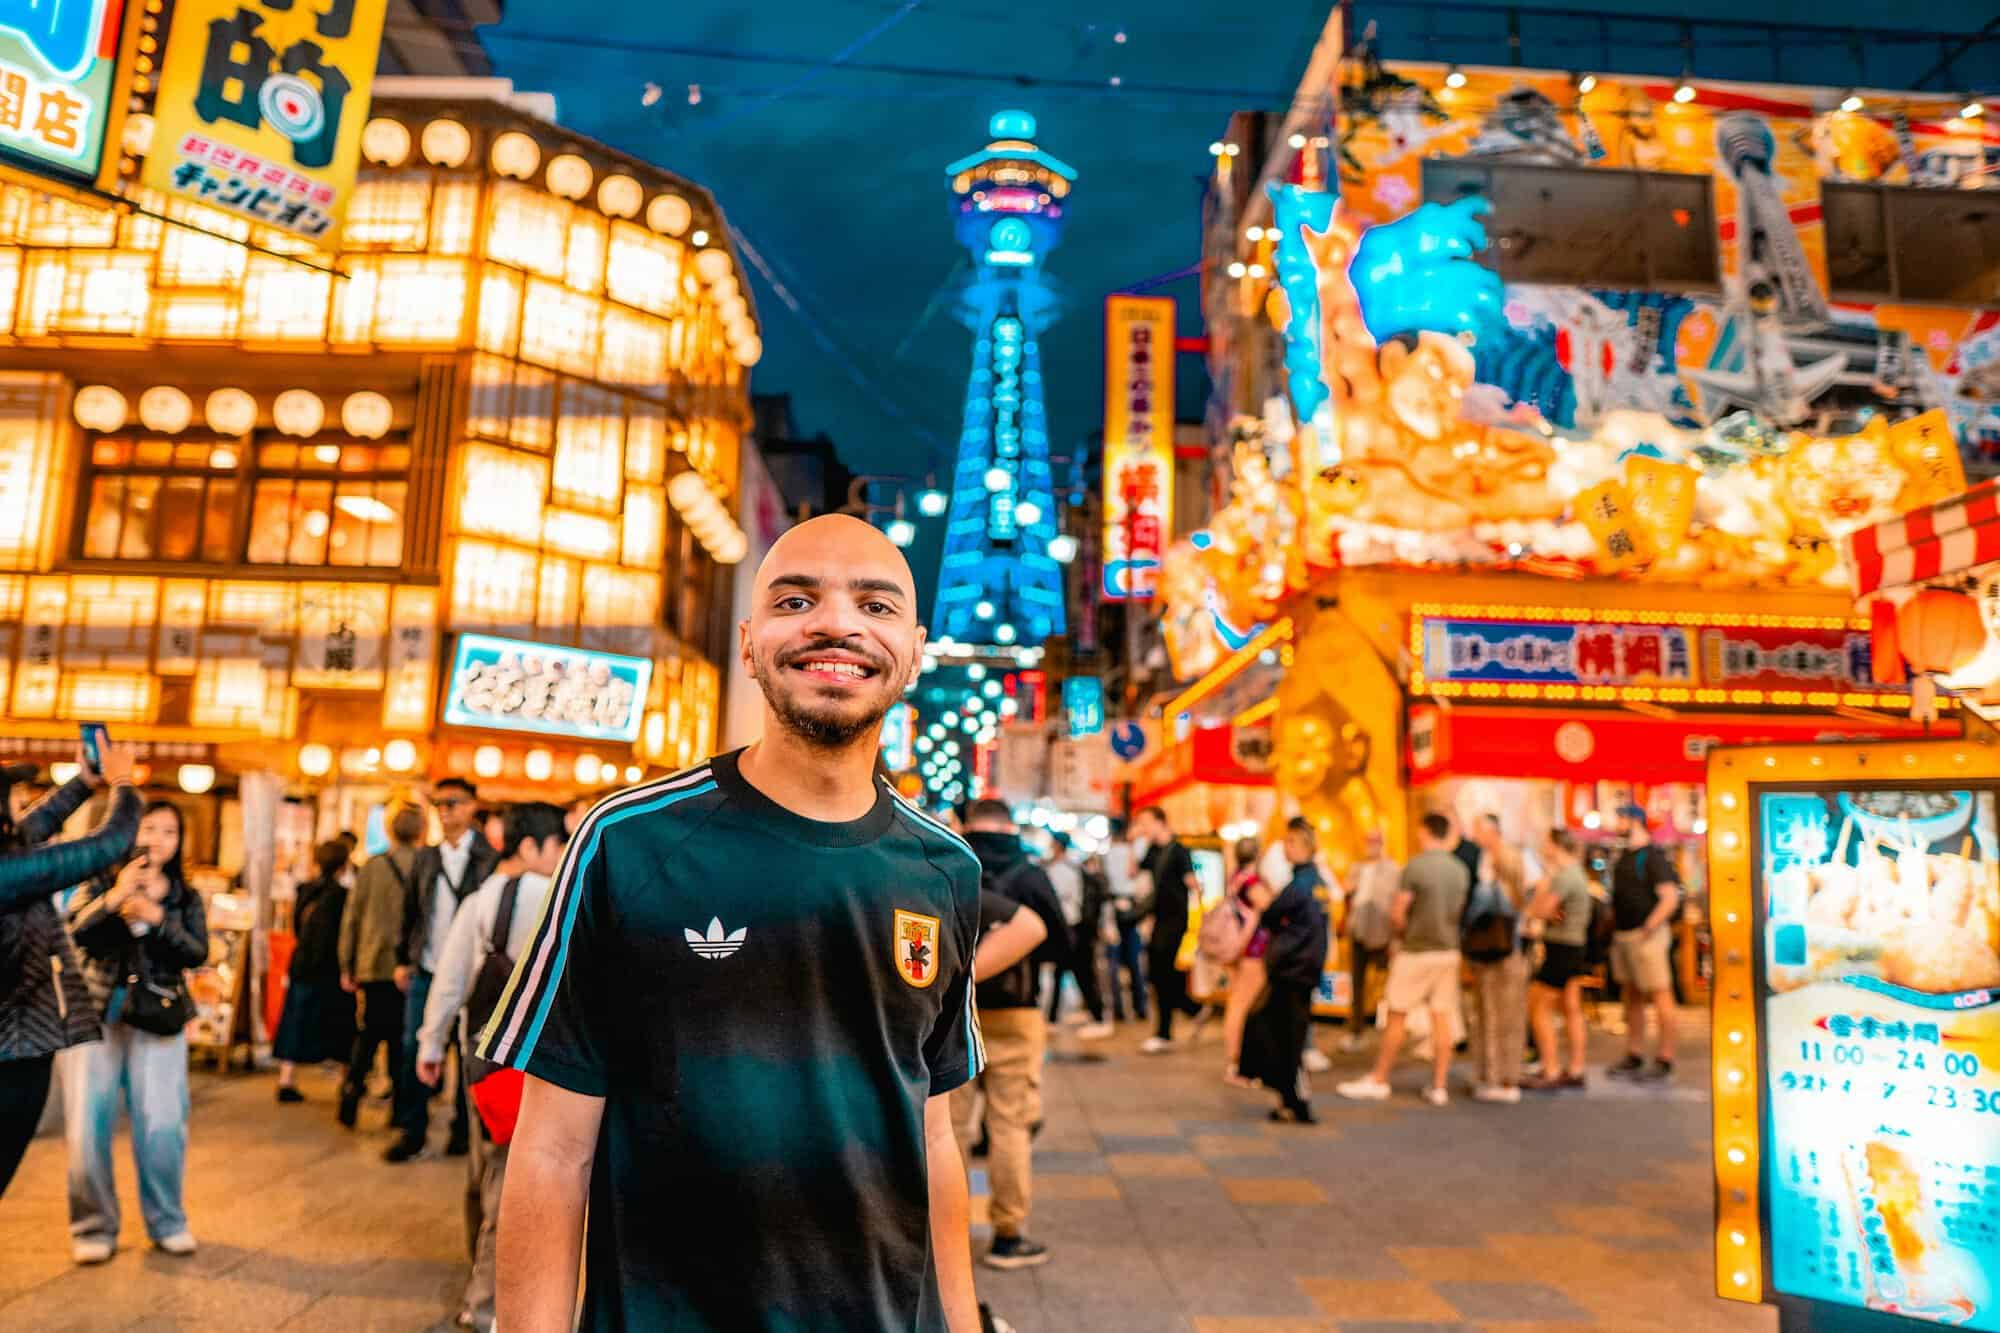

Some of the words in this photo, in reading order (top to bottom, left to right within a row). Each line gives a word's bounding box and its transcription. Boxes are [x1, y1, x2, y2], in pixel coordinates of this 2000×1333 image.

[194, 0, 356, 168] 的
[1801, 1041, 1864, 1065] 1100
[1896, 1049, 1979, 1077] 2400
